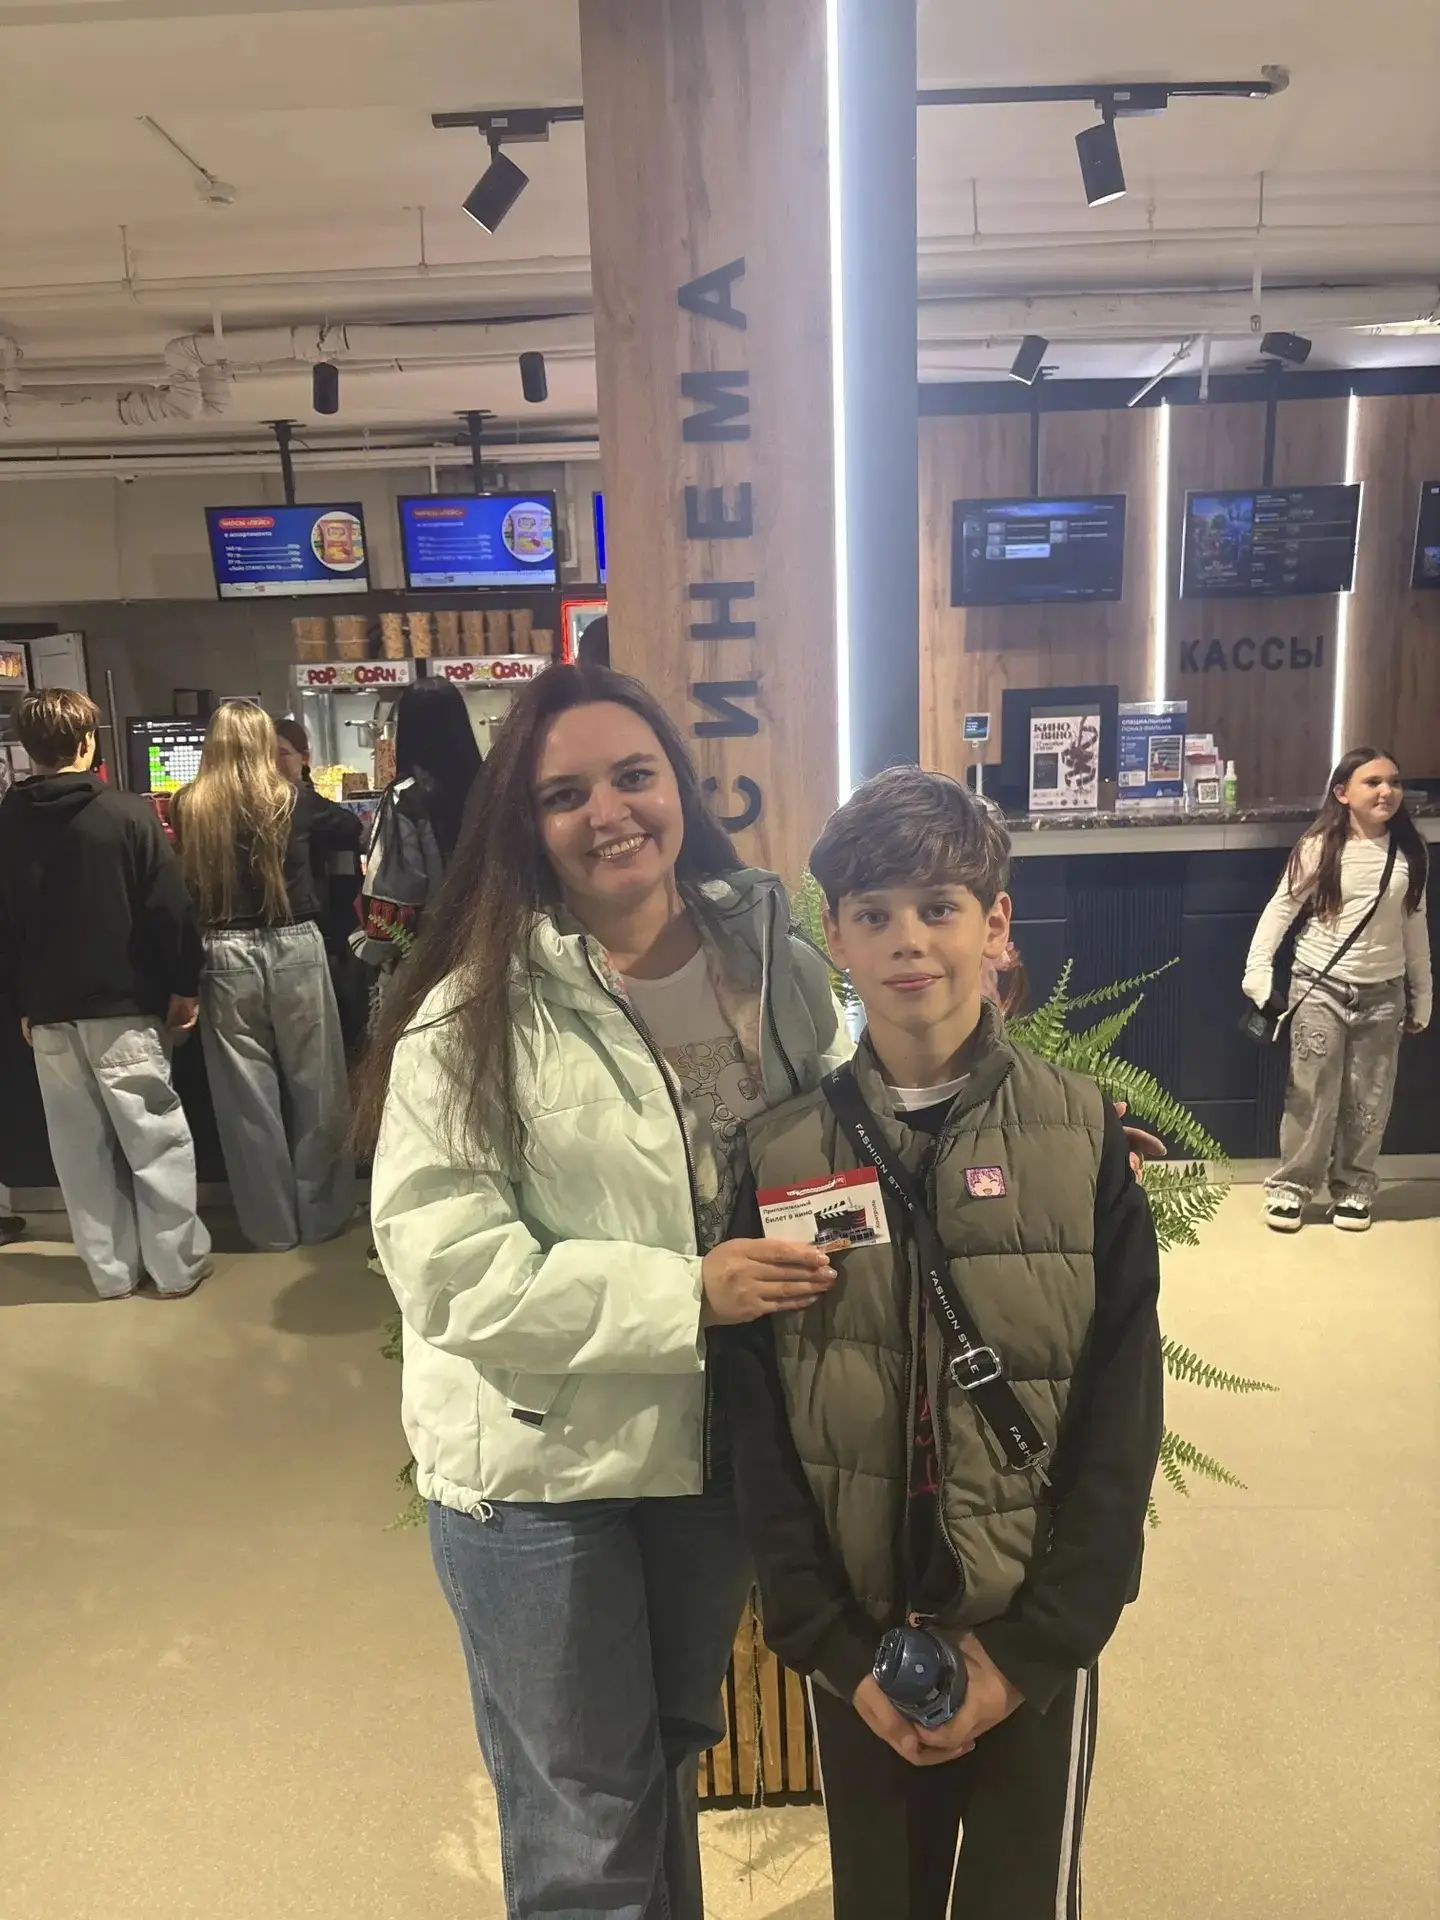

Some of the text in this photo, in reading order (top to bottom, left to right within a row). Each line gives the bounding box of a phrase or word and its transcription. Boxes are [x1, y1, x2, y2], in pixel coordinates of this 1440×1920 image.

[677, 256, 762, 833] СИНЕМА
[1179, 635, 1324, 673] КАССЫ
[307, 665, 396, 685] POP CORN
[444, 661, 532, 680] POP CORN
[1033, 722, 1070, 732] КИНО
[1041, 731, 1072, 740] ВИНО
[855, 1123, 915, 1211] FASHION STYLE
[794, 1209, 813, 1219] кино
[929, 1270, 980, 1374] FASHION STLE
